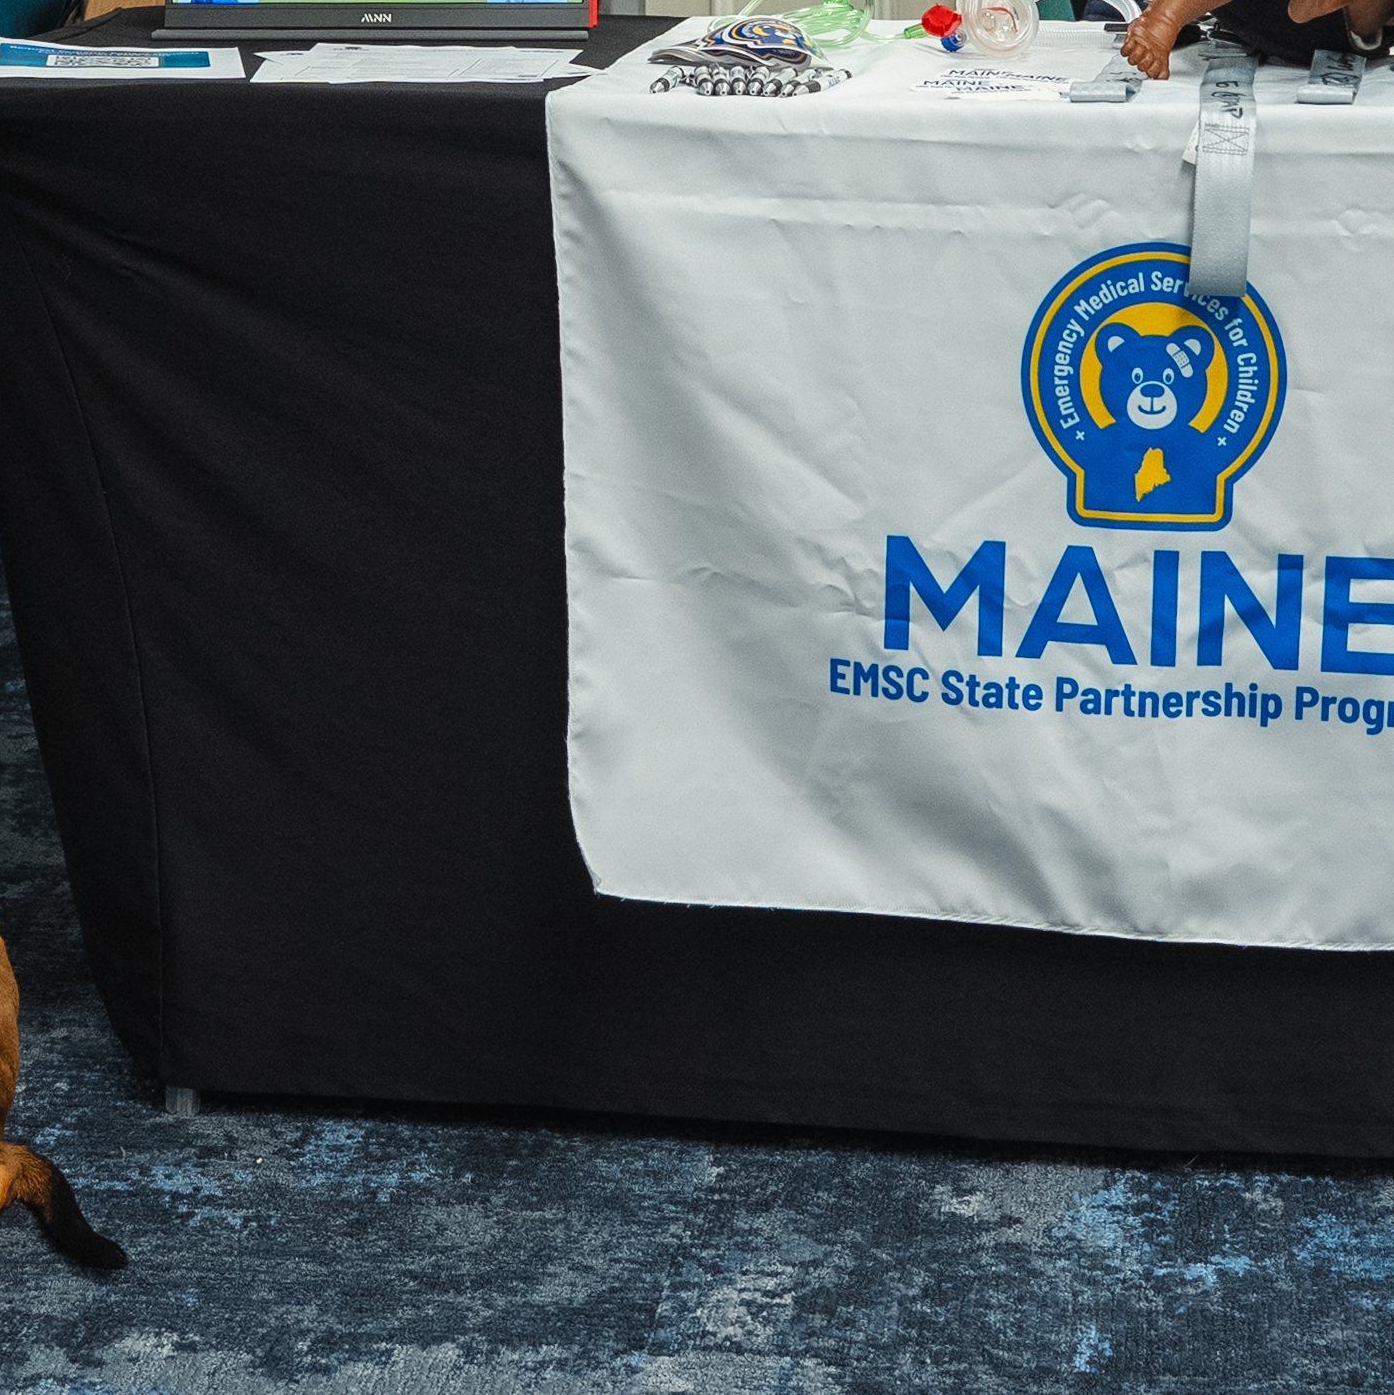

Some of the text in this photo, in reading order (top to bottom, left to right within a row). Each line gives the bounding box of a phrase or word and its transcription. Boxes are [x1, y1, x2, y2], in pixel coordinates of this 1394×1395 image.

[1073, 271, 1145, 322] Medical
[1224, 317, 1249, 347] for
[1053, 317, 1085, 430] Emergency
[1223, 351, 1260, 435] Children
[830, 657, 931, 703] EMSC
[940, 669, 1043, 712] State
[1055, 676, 1283, 727] Partnership
